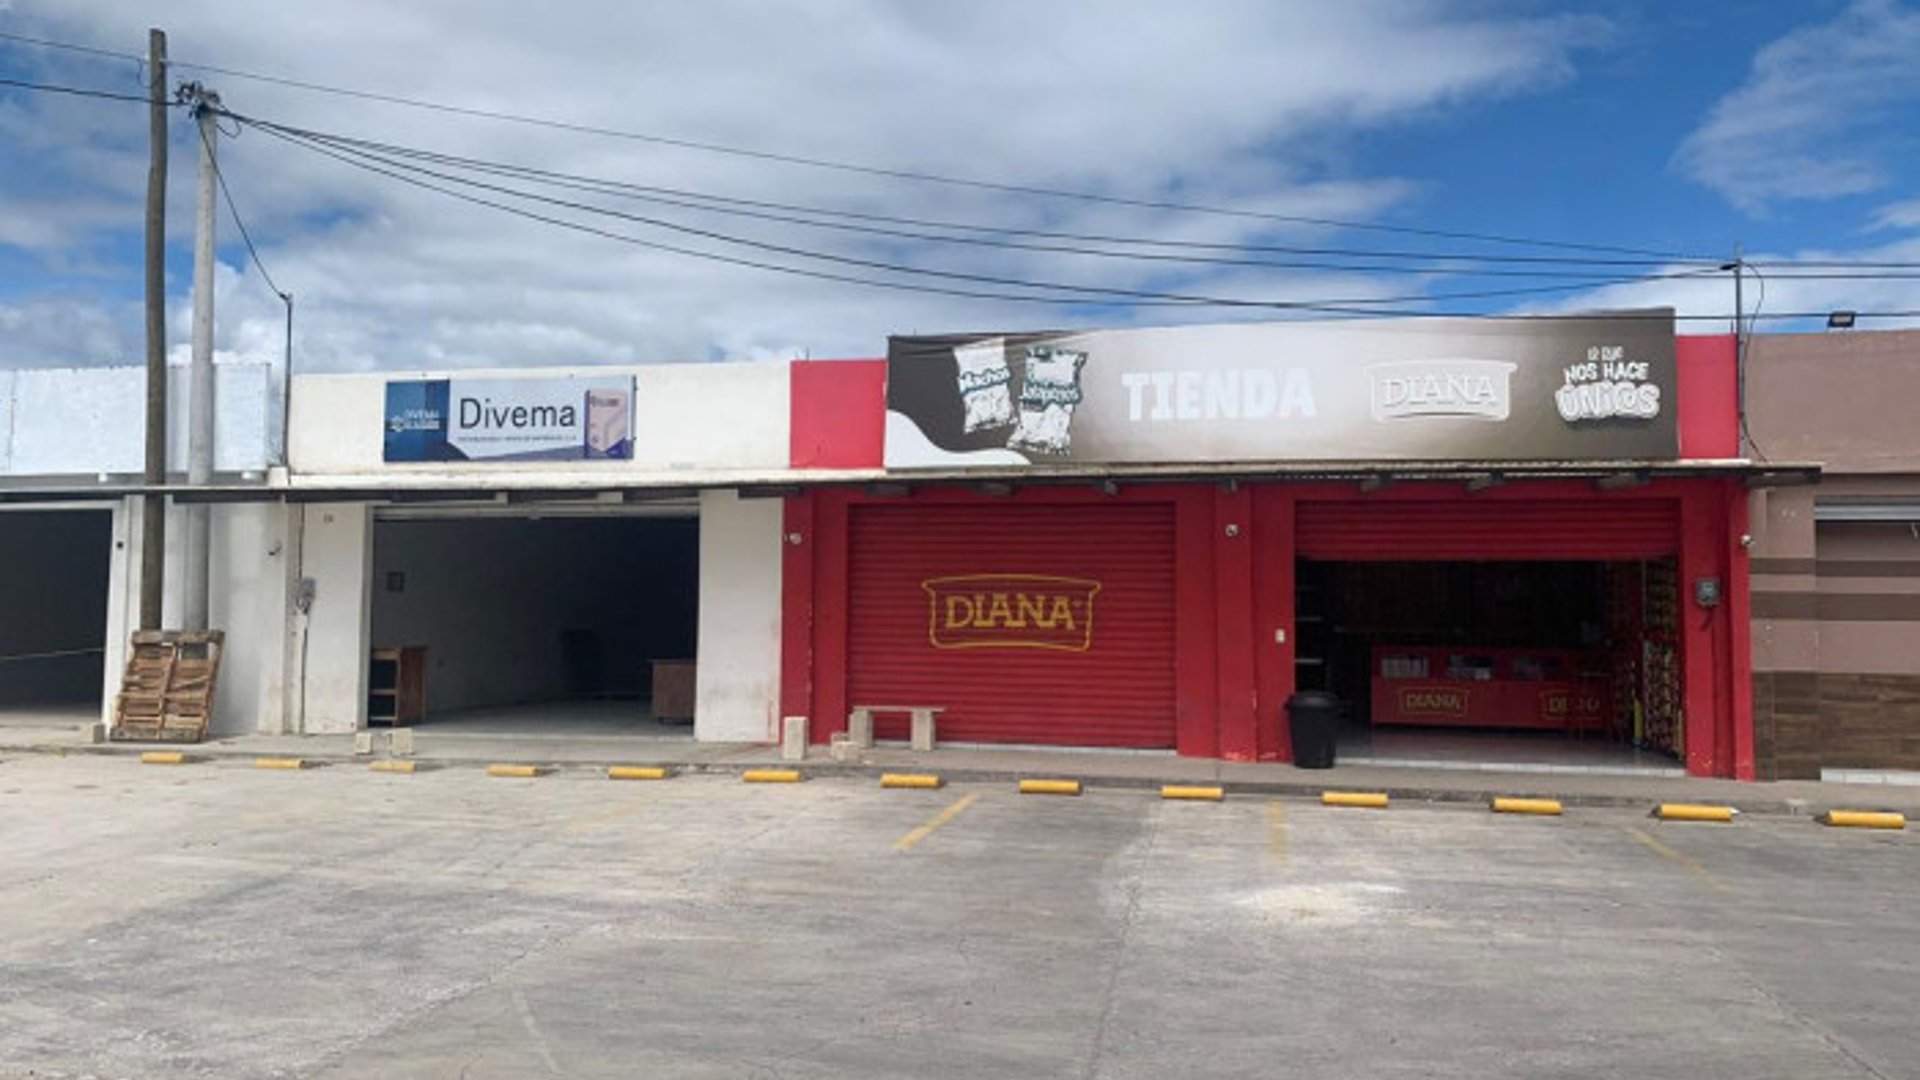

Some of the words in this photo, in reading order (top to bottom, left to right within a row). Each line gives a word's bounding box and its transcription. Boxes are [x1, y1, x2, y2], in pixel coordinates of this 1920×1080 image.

[1564, 362, 1598, 385] NOS
[1603, 361, 1650, 381] HACE
[1120, 368, 1317, 422] TIENDA
[1382, 374, 1498, 407] DIANA
[459, 397, 577, 430] Divema
[945, 592, 1076, 631] DIANA
